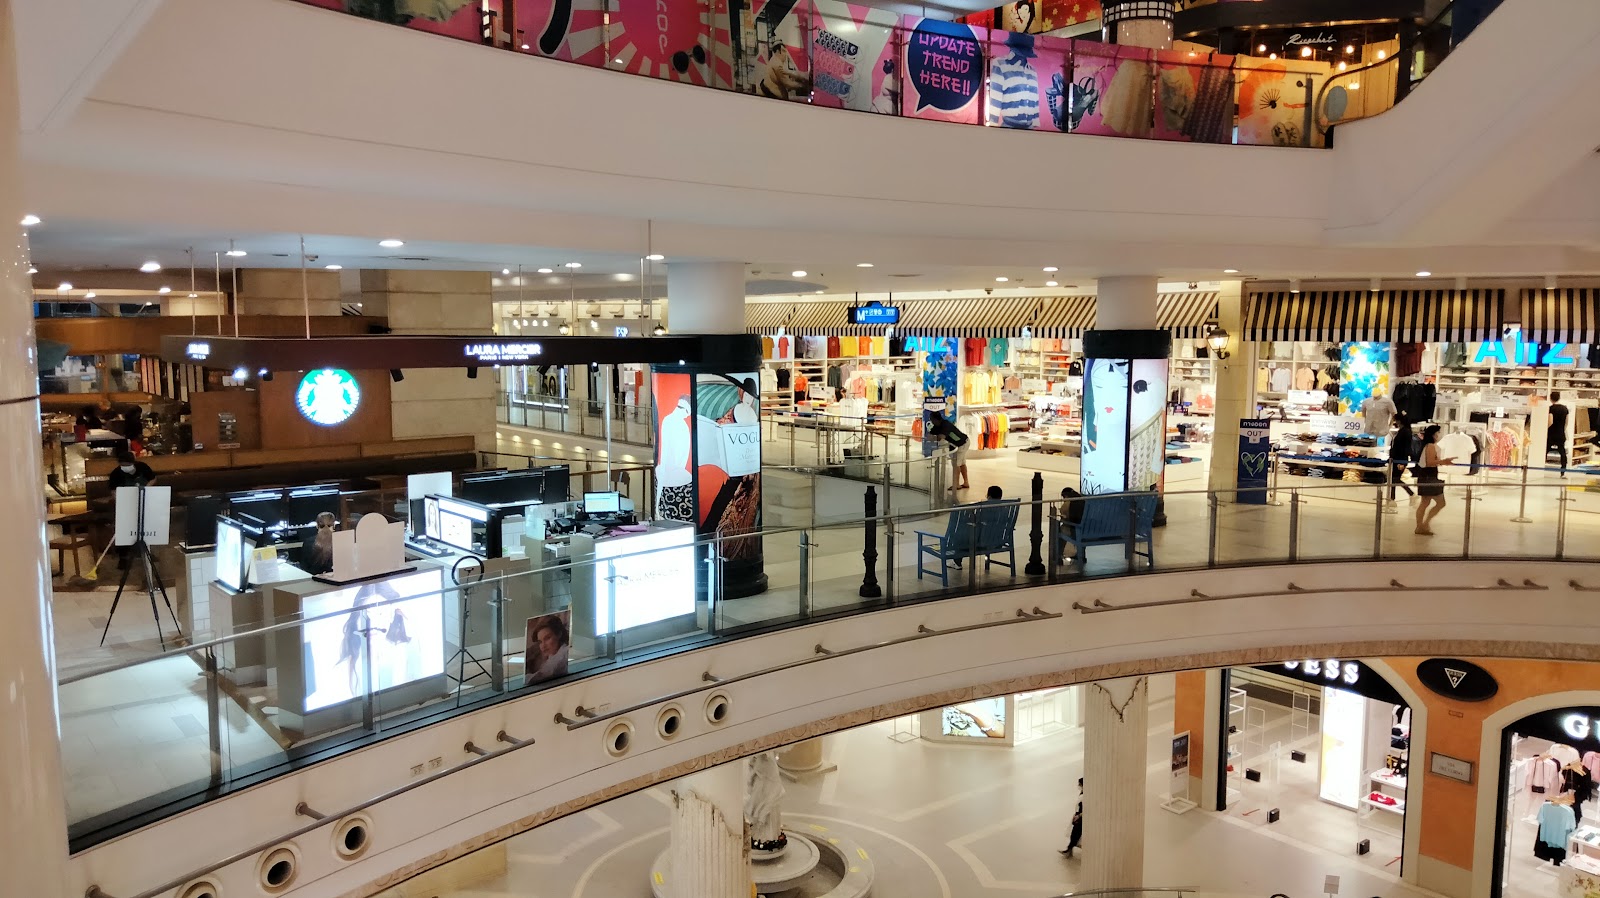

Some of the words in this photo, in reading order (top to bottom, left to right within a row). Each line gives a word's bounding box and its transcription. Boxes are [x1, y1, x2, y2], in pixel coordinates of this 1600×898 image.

[918, 32, 976, 57] UPDATE
[922, 49, 970, 74] TREND
[919, 69, 971, 96] HERE!!
[465, 344, 500, 355] LAURA
[501, 343, 541, 355] MERCIER
[1344, 421, 1361, 431] 299
